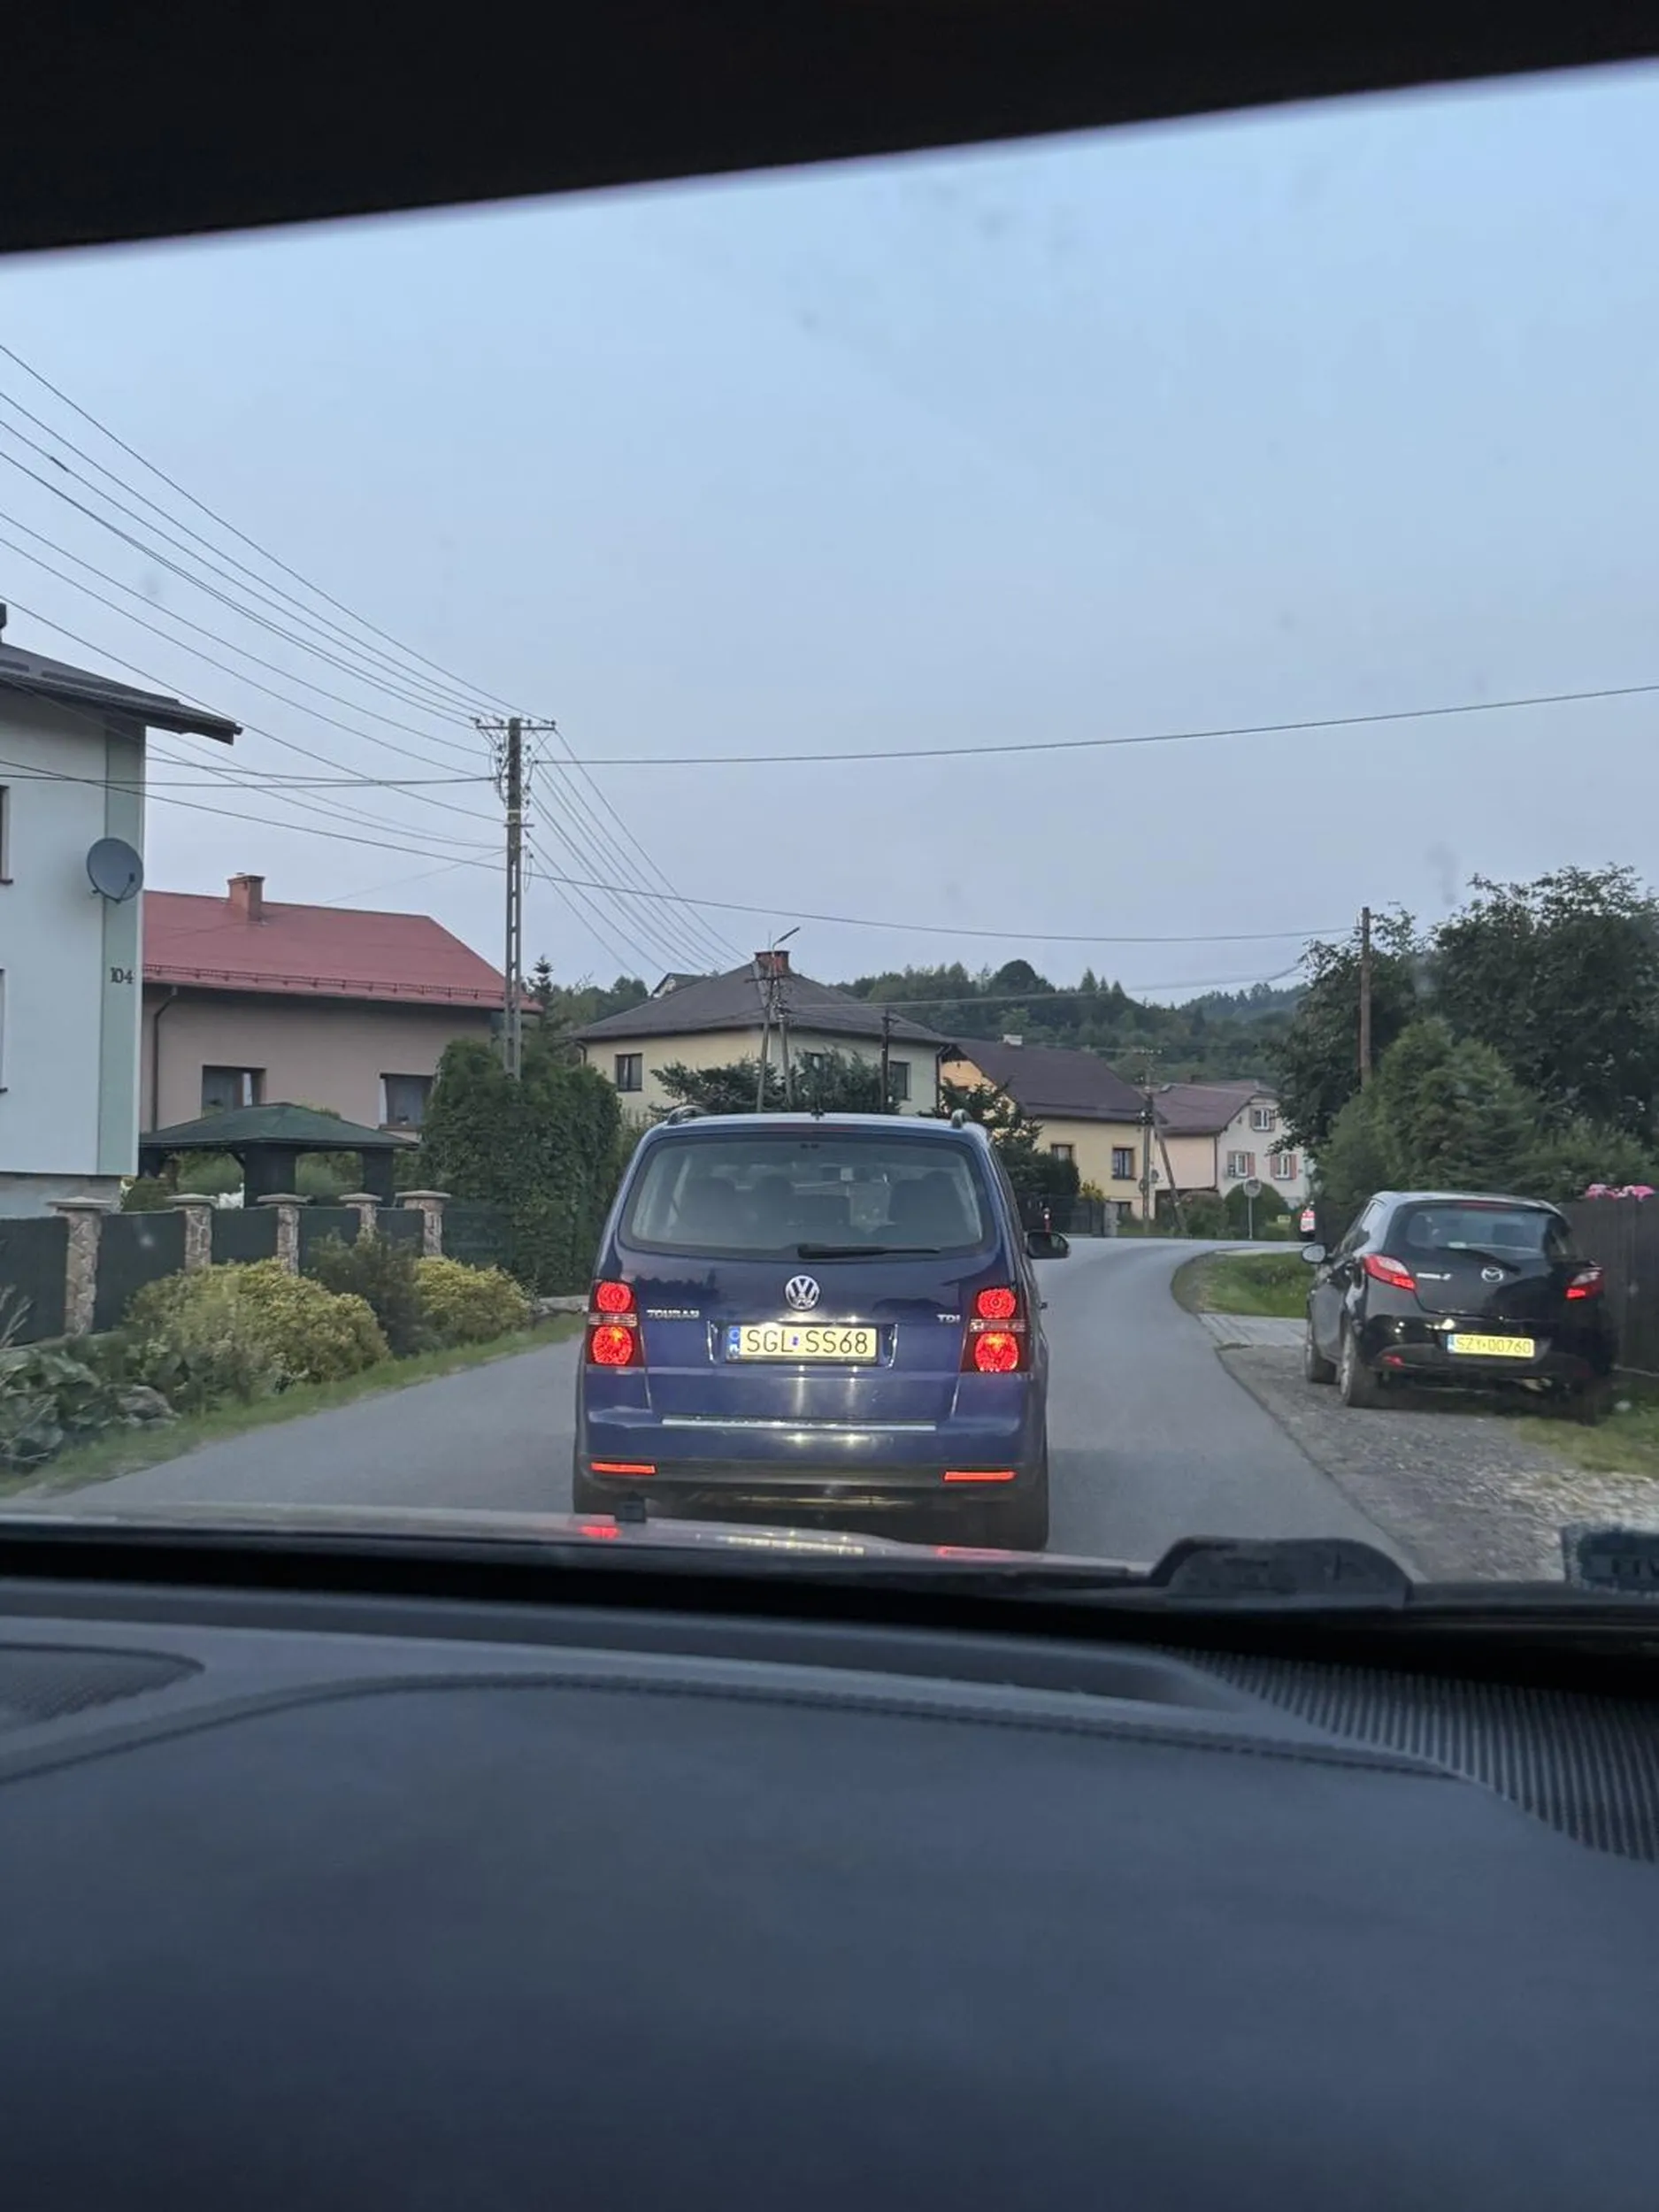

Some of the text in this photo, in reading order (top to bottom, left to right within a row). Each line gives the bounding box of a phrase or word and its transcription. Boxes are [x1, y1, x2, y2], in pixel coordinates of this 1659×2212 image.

[110, 966, 135, 984] 104
[937, 1313, 961, 1324] TDI
[746, 1329, 794, 1353] SGL
[805, 1330, 868, 1355] SS68
